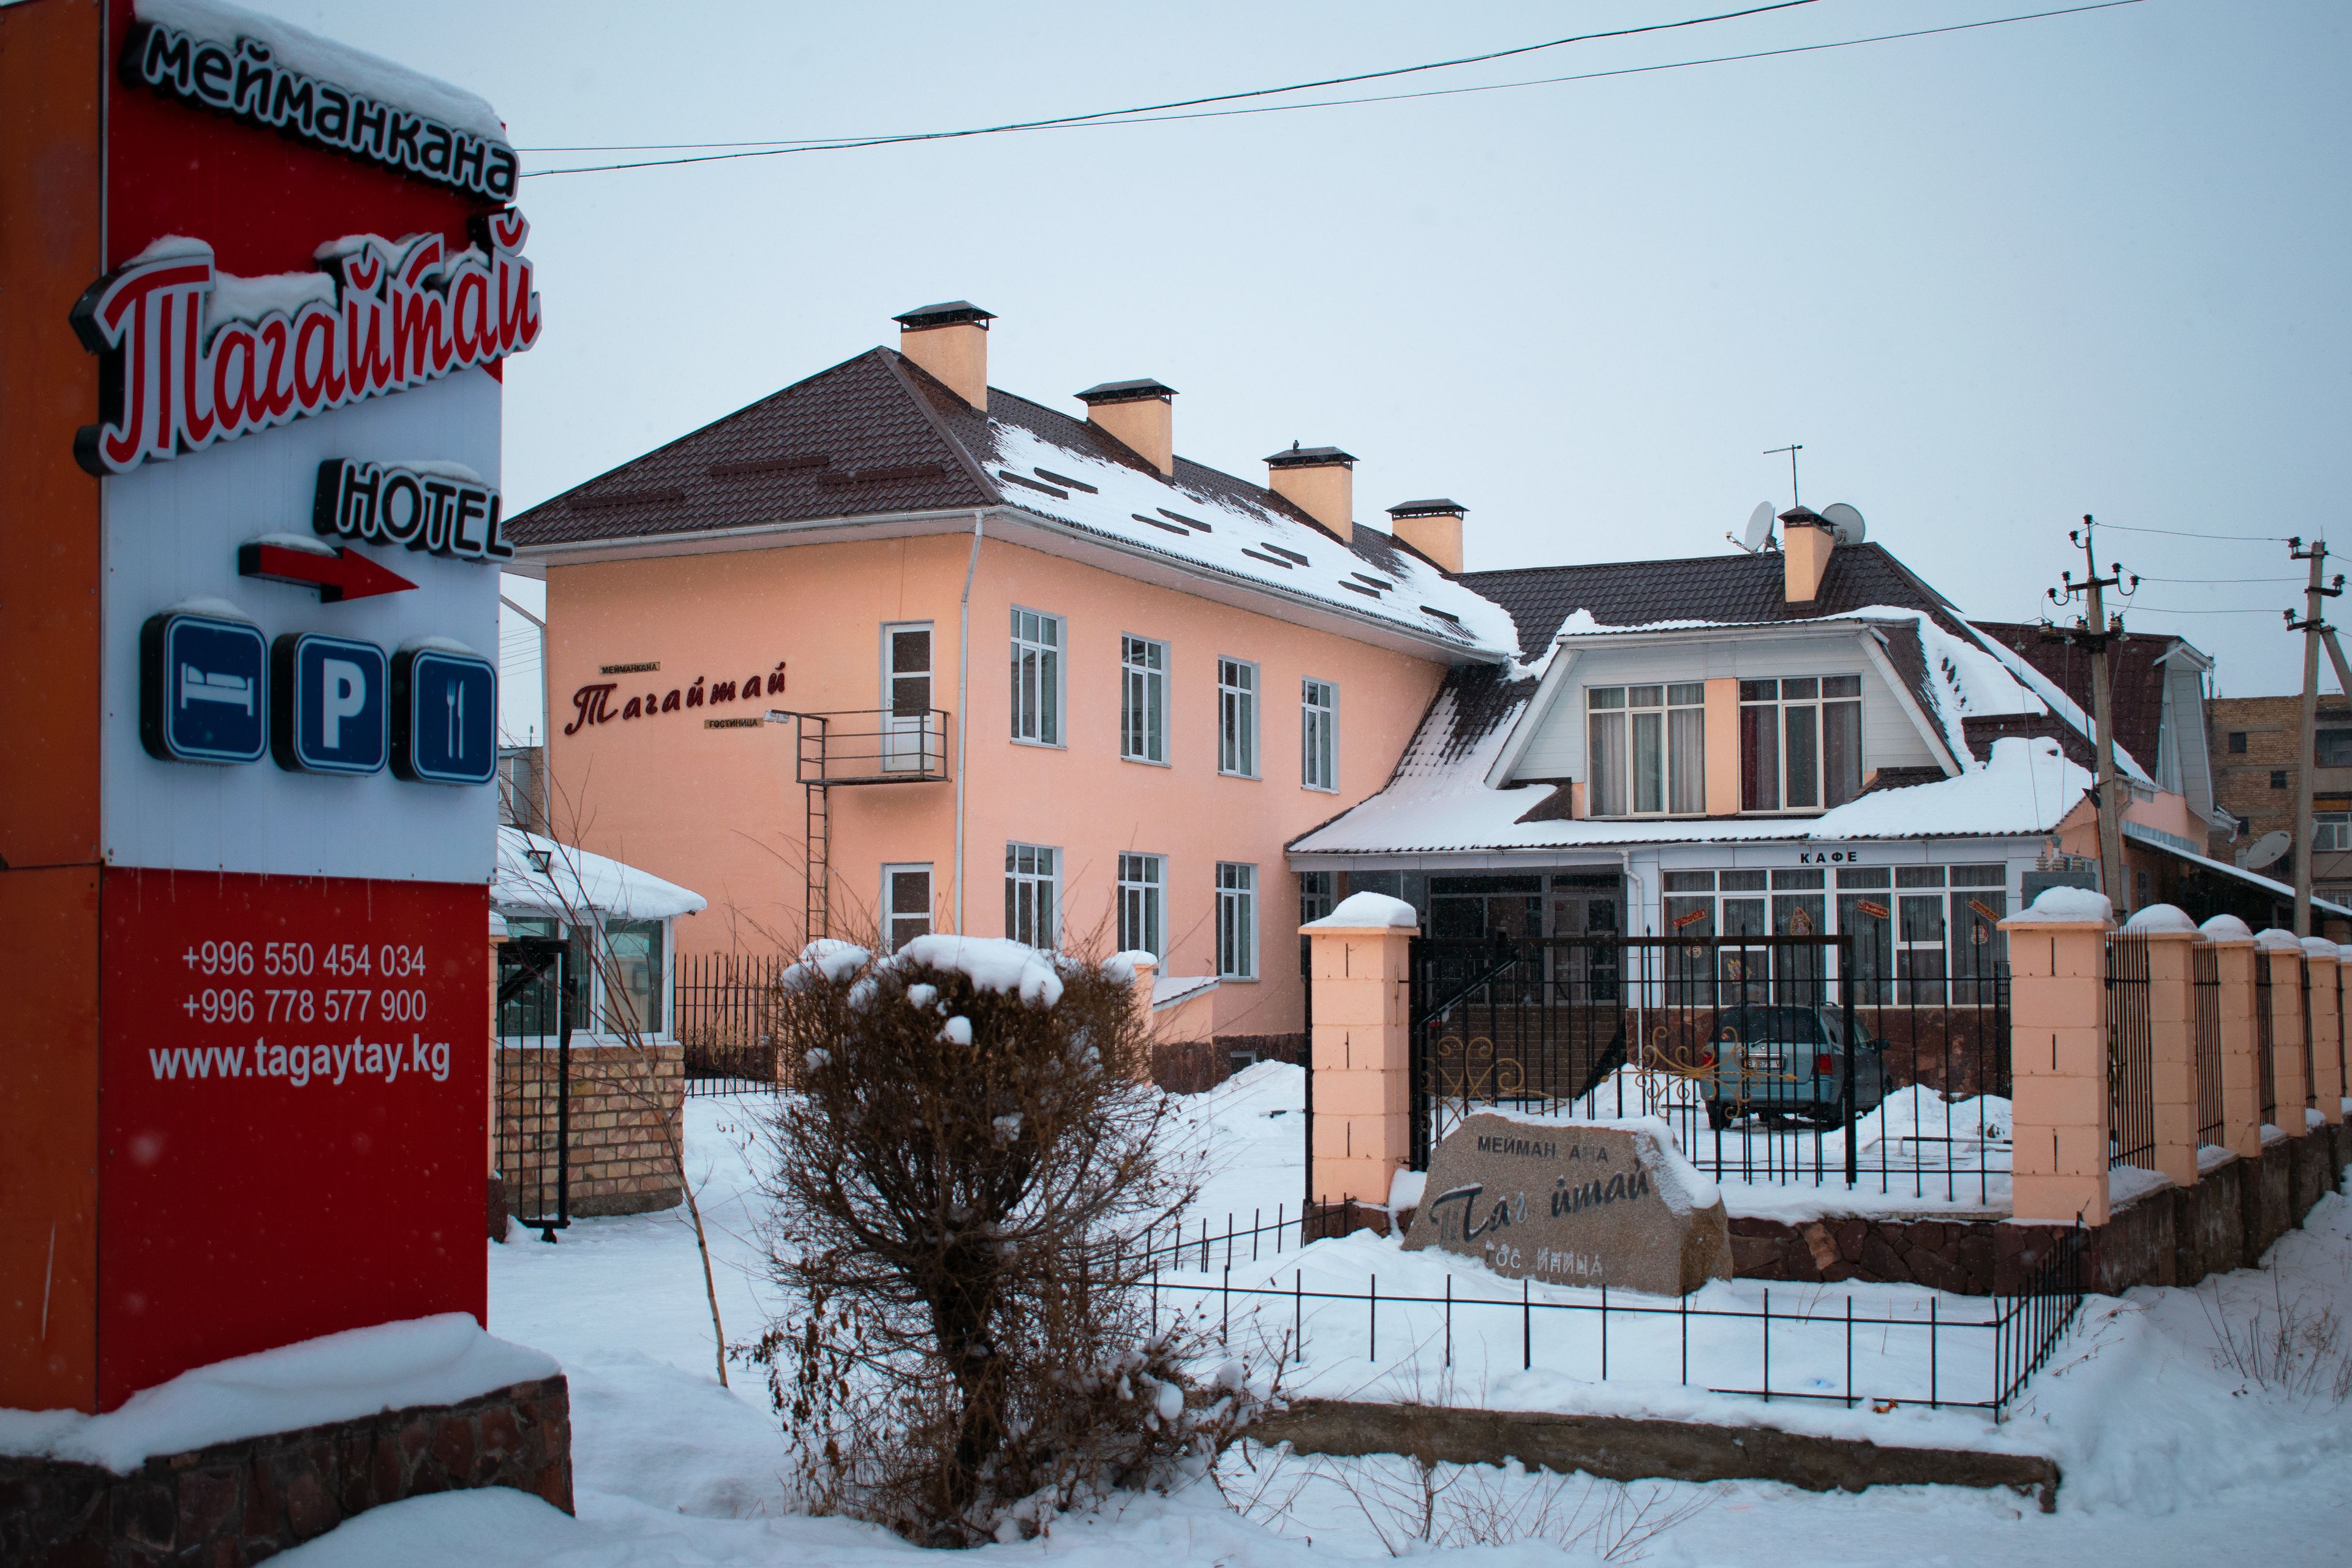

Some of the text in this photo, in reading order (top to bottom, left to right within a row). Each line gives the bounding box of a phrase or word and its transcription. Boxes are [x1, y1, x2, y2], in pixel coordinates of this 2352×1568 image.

[145, 27, 516, 198] мейманкана
[103, 217, 539, 463] Тагайтай
[341, 464, 513, 557] HOTEL
[602, 663, 657, 674] МЕЙМАНКАНА
[564, 662, 786, 736] Тагайтай
[709, 718, 758, 728] ГОСТИНИЦА
[1800, 851, 1857, 864] КАФЕ
[183, 940, 426, 977] +996 550 454 034
[183, 989, 427, 1023] +996 778 577 900
[149, 1033, 450, 1087] www.tagaytay.kg
[1428, 1156, 1649, 1248] Тагйтай
